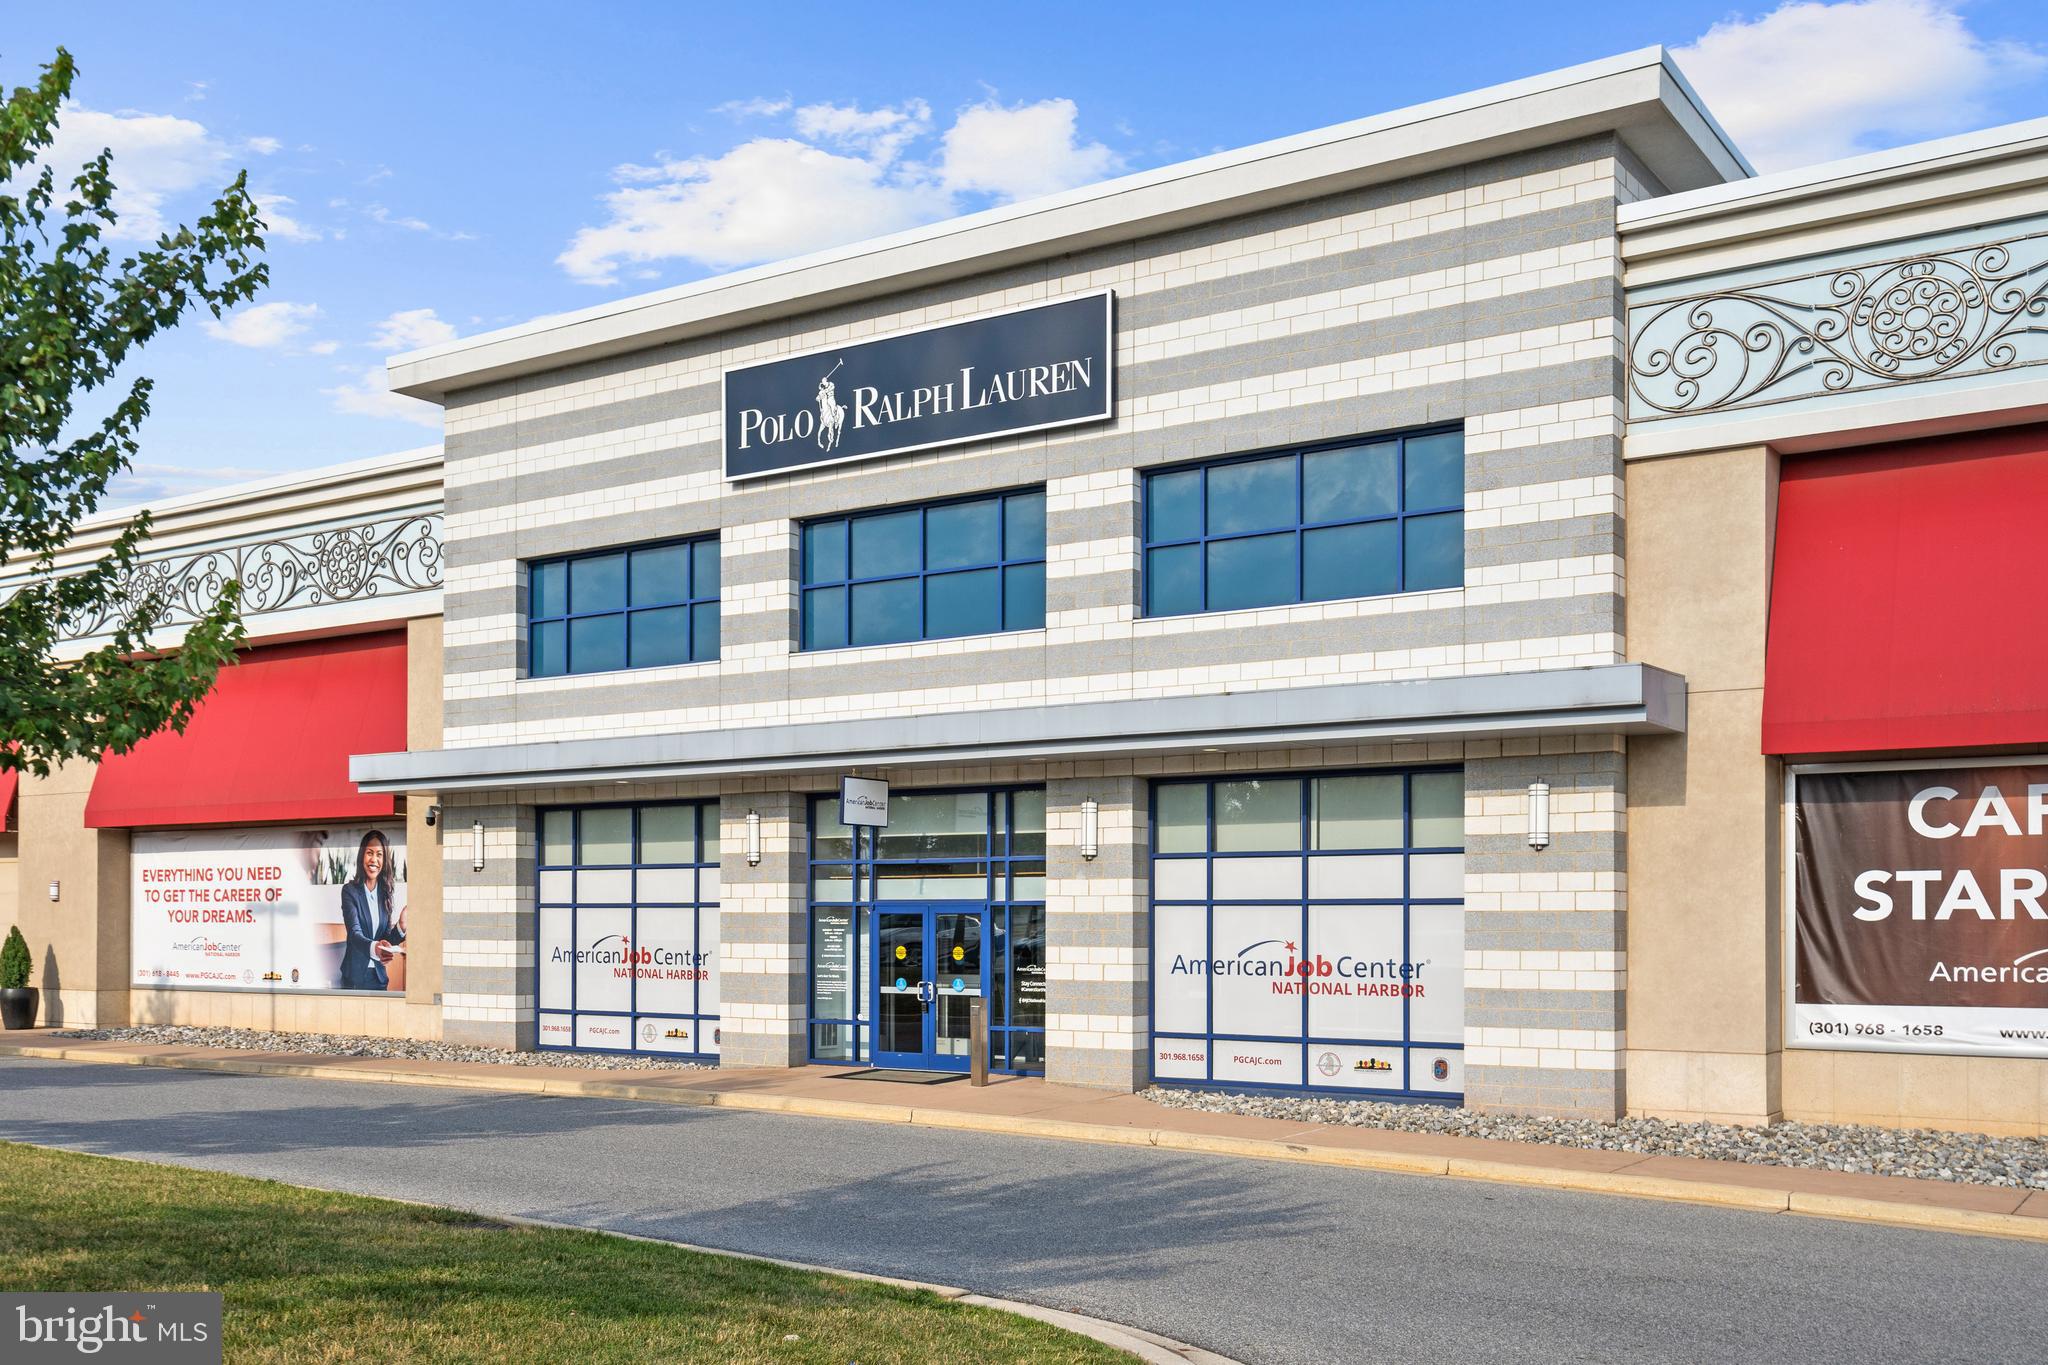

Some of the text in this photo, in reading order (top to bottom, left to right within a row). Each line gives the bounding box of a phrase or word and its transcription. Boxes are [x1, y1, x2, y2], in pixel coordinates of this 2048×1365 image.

[738, 357, 1092, 450] POLO RALPH LAUREN
[143, 866, 282, 882] EVERYTHING YOU NEED
[145, 887, 282, 902] TO GET THE CAREER OF
[1852, 869, 2048, 922] STAR
[168, 909, 256, 923] YOUR DREAMS.
[613, 967, 709, 981] NATIONAL HARBOR
[1929, 961, 2048, 984] America
[1272, 981, 1425, 998] NATIONAL HARBOR
[589, 1027, 620, 1036] PGCAJC.com
[1809, 1021, 1849, 1036] (301)
[1855, 1023, 1885, 1036] 968
[1902, 1024, 1944, 1036] 1658
[1160, 1052, 1282, 1067] 301.968.1658 PGCAJC.com
